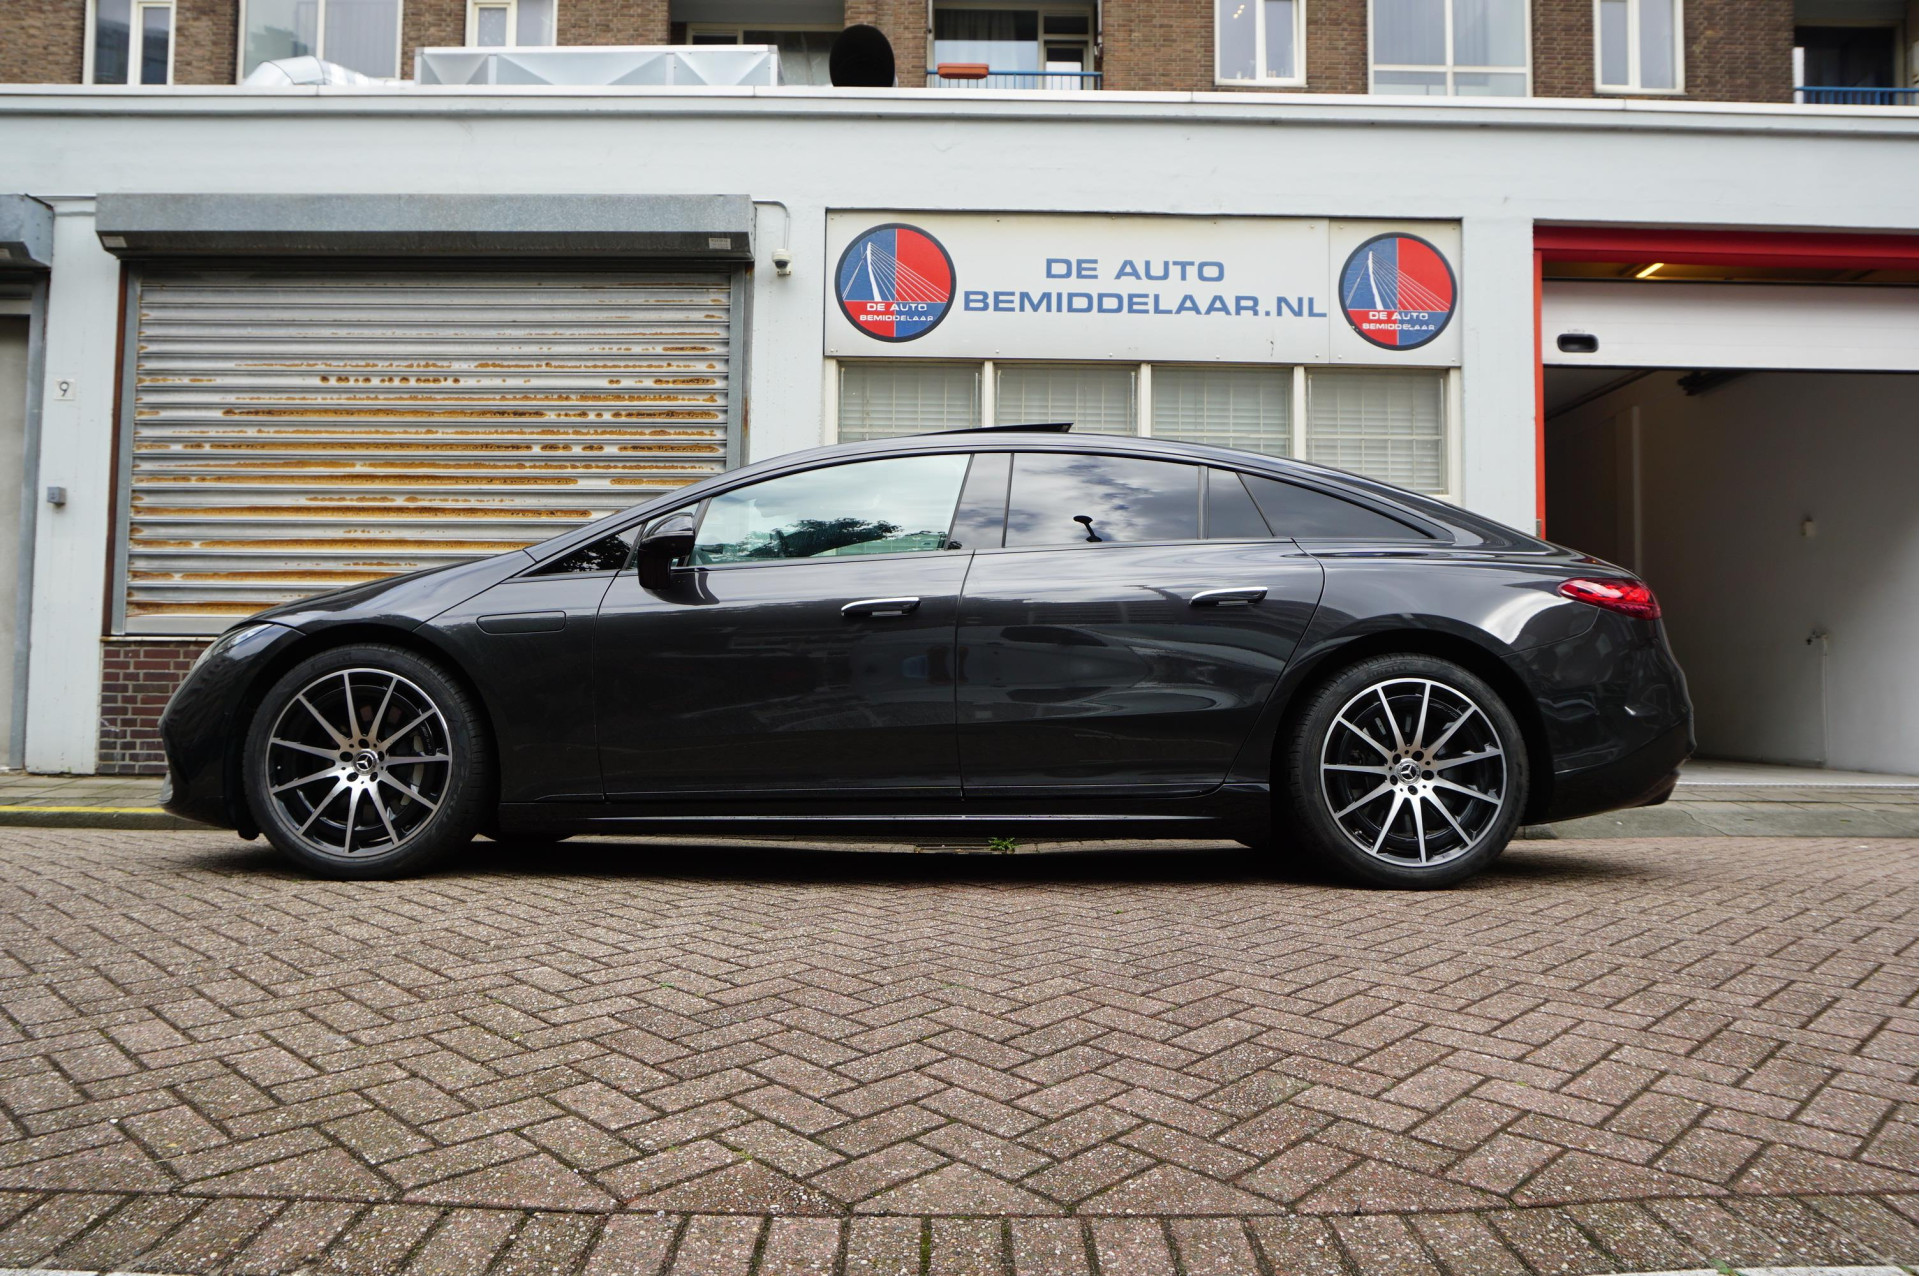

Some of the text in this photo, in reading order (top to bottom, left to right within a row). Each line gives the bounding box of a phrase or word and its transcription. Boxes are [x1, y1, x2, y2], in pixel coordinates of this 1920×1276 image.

[1045, 258, 1225, 282] DE AUTO
[866, 303, 928, 311] DE AUTO
[963, 290, 1328, 318] BEMIDDELAAR.NL
[859, 314, 934, 322] BEMIDDELAAR
[1368, 311, 1429, 320] DE AUTO
[1361, 322, 1435, 331] BEMIDDELAAR
[59, 381, 70, 397] 9
